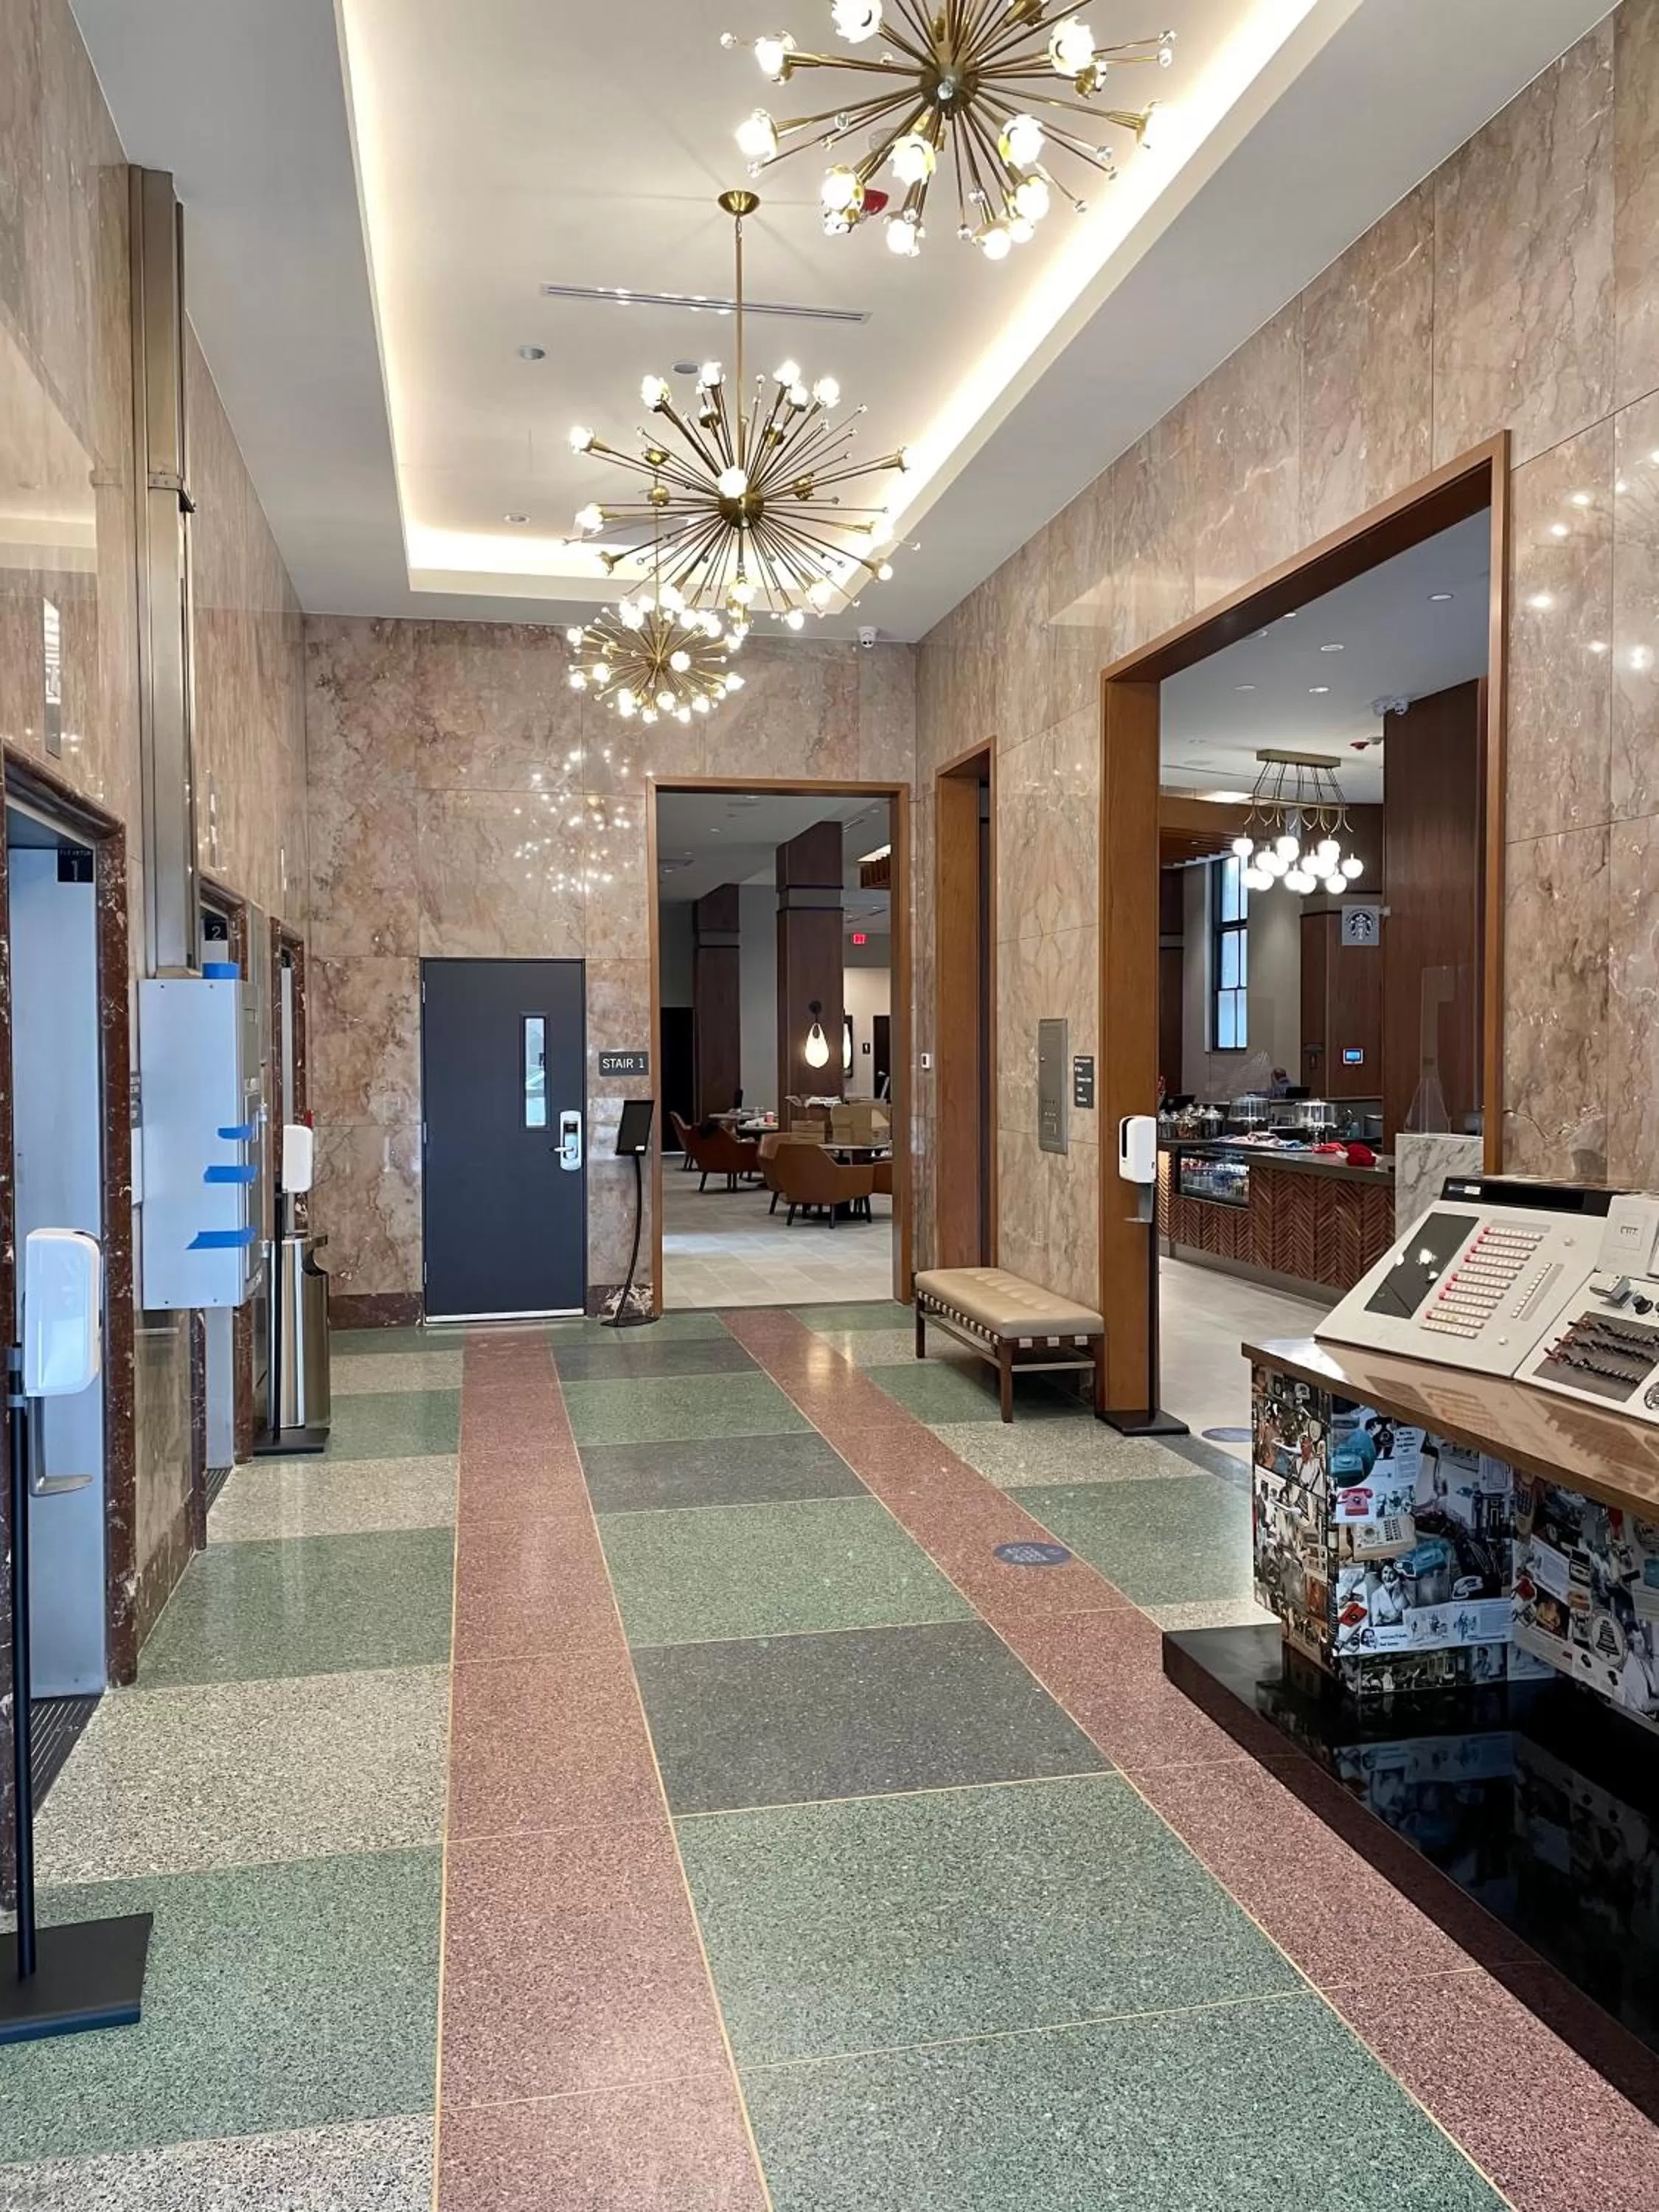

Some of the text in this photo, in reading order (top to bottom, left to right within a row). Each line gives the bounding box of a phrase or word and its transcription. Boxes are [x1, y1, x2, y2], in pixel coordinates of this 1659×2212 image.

[71, 860, 78, 882] 1
[212, 925, 221, 941] 2
[602, 1058, 644, 1068] STAIR 1
